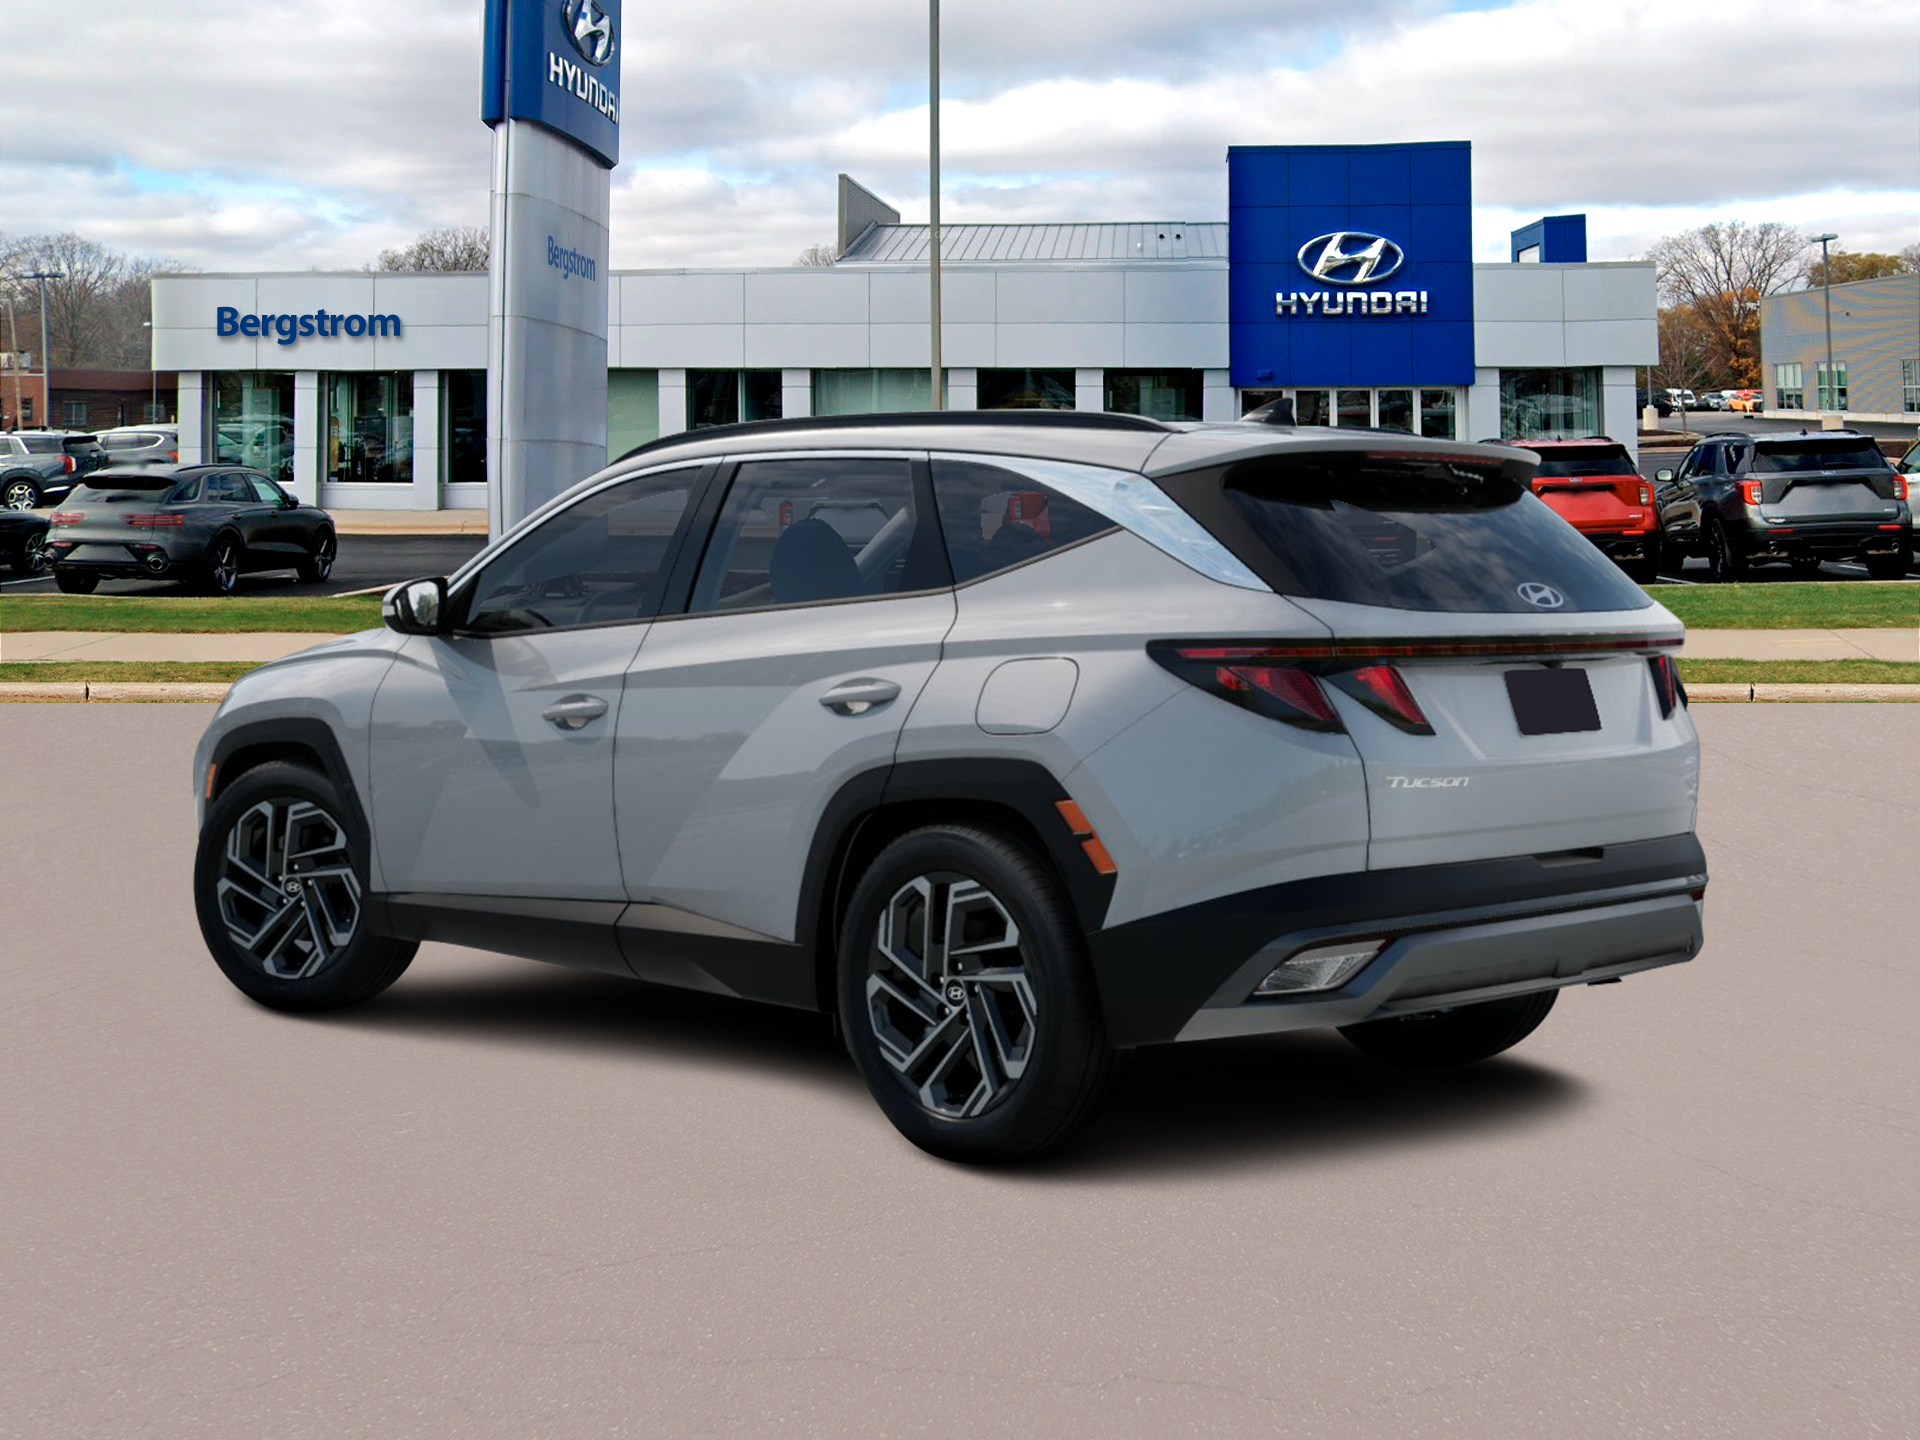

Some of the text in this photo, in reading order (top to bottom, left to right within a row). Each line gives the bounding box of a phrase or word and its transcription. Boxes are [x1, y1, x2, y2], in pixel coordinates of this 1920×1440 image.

[549, 52, 619, 124] HYUNDAI
[547, 235, 596, 282] Bergstrom
[1275, 291, 1428, 315] HYUNDAI
[216, 306, 401, 346] Bergstrom
